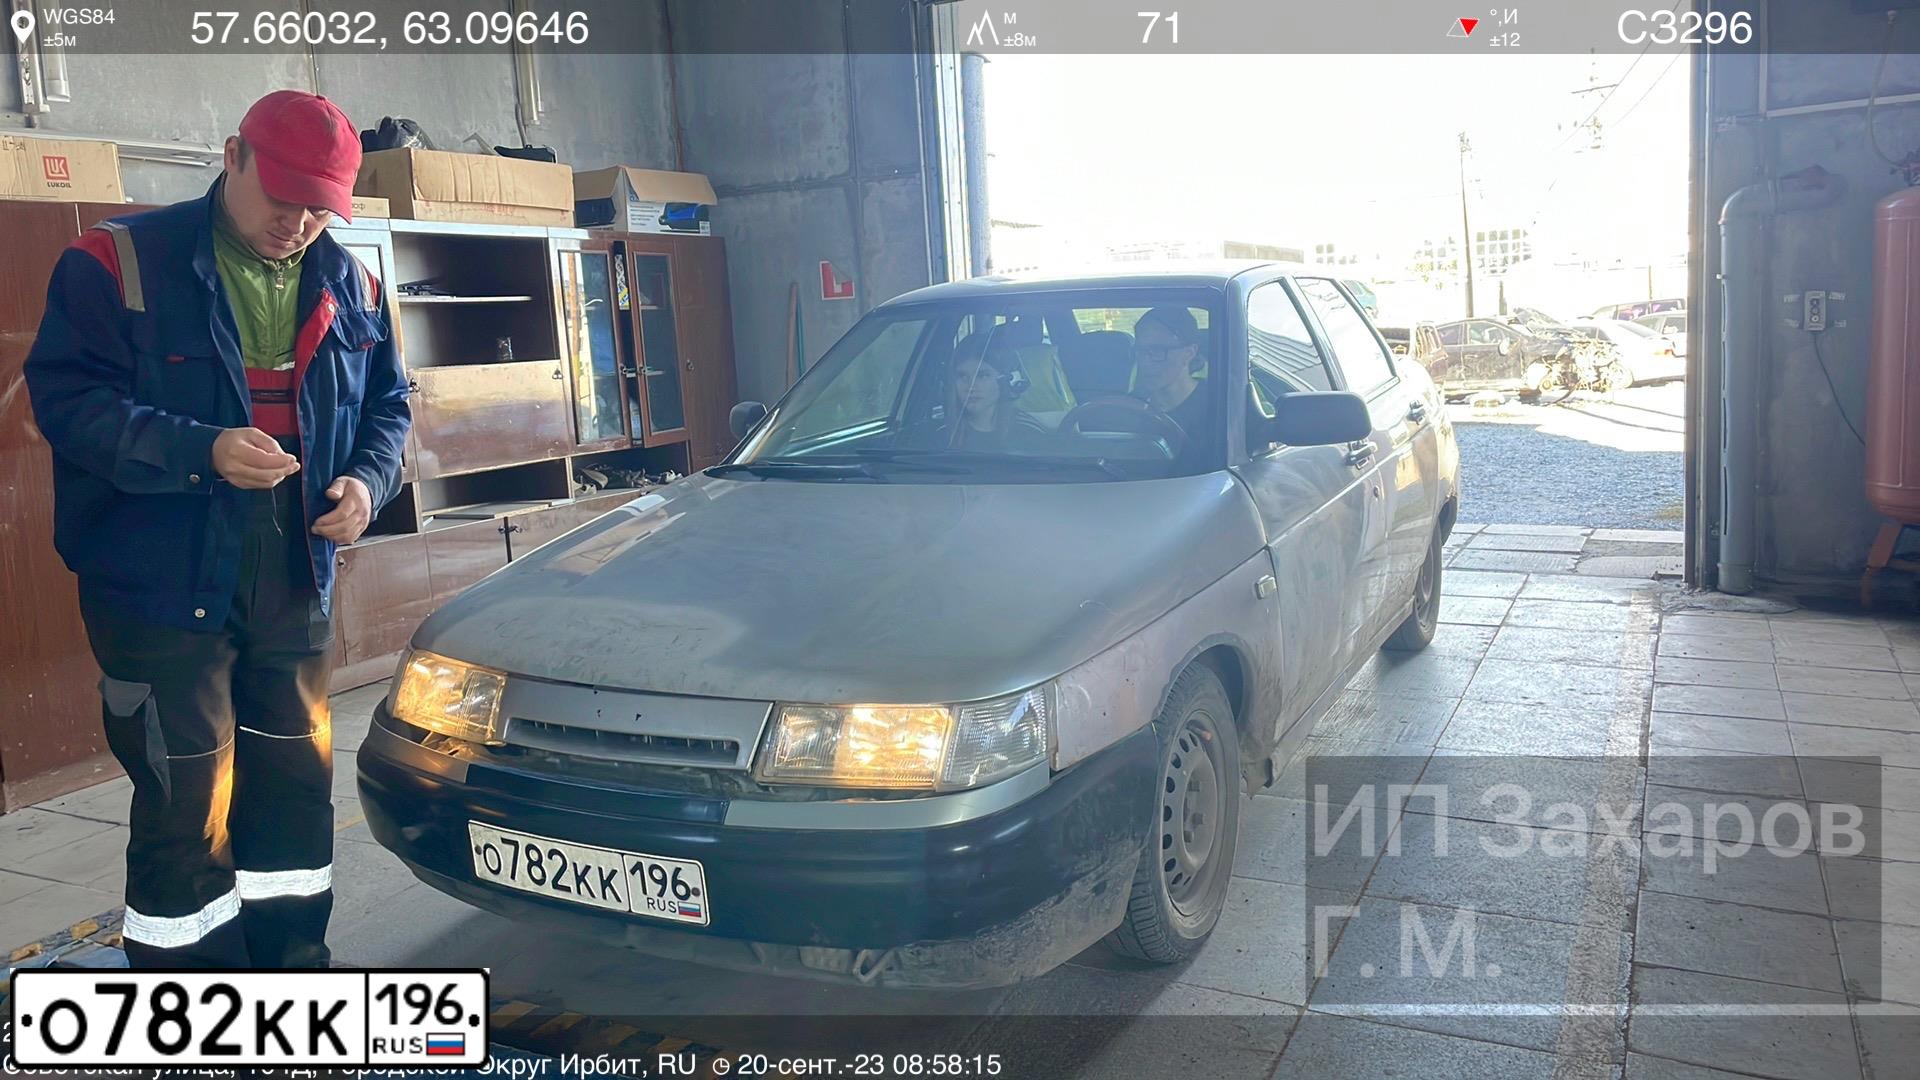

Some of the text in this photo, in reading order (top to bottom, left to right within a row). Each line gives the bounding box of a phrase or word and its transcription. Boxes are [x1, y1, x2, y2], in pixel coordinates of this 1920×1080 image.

[47, 181, 72, 189] LUKOIL
[629, 861, 692, 901] 196
[646, 897, 677, 913] RUS
